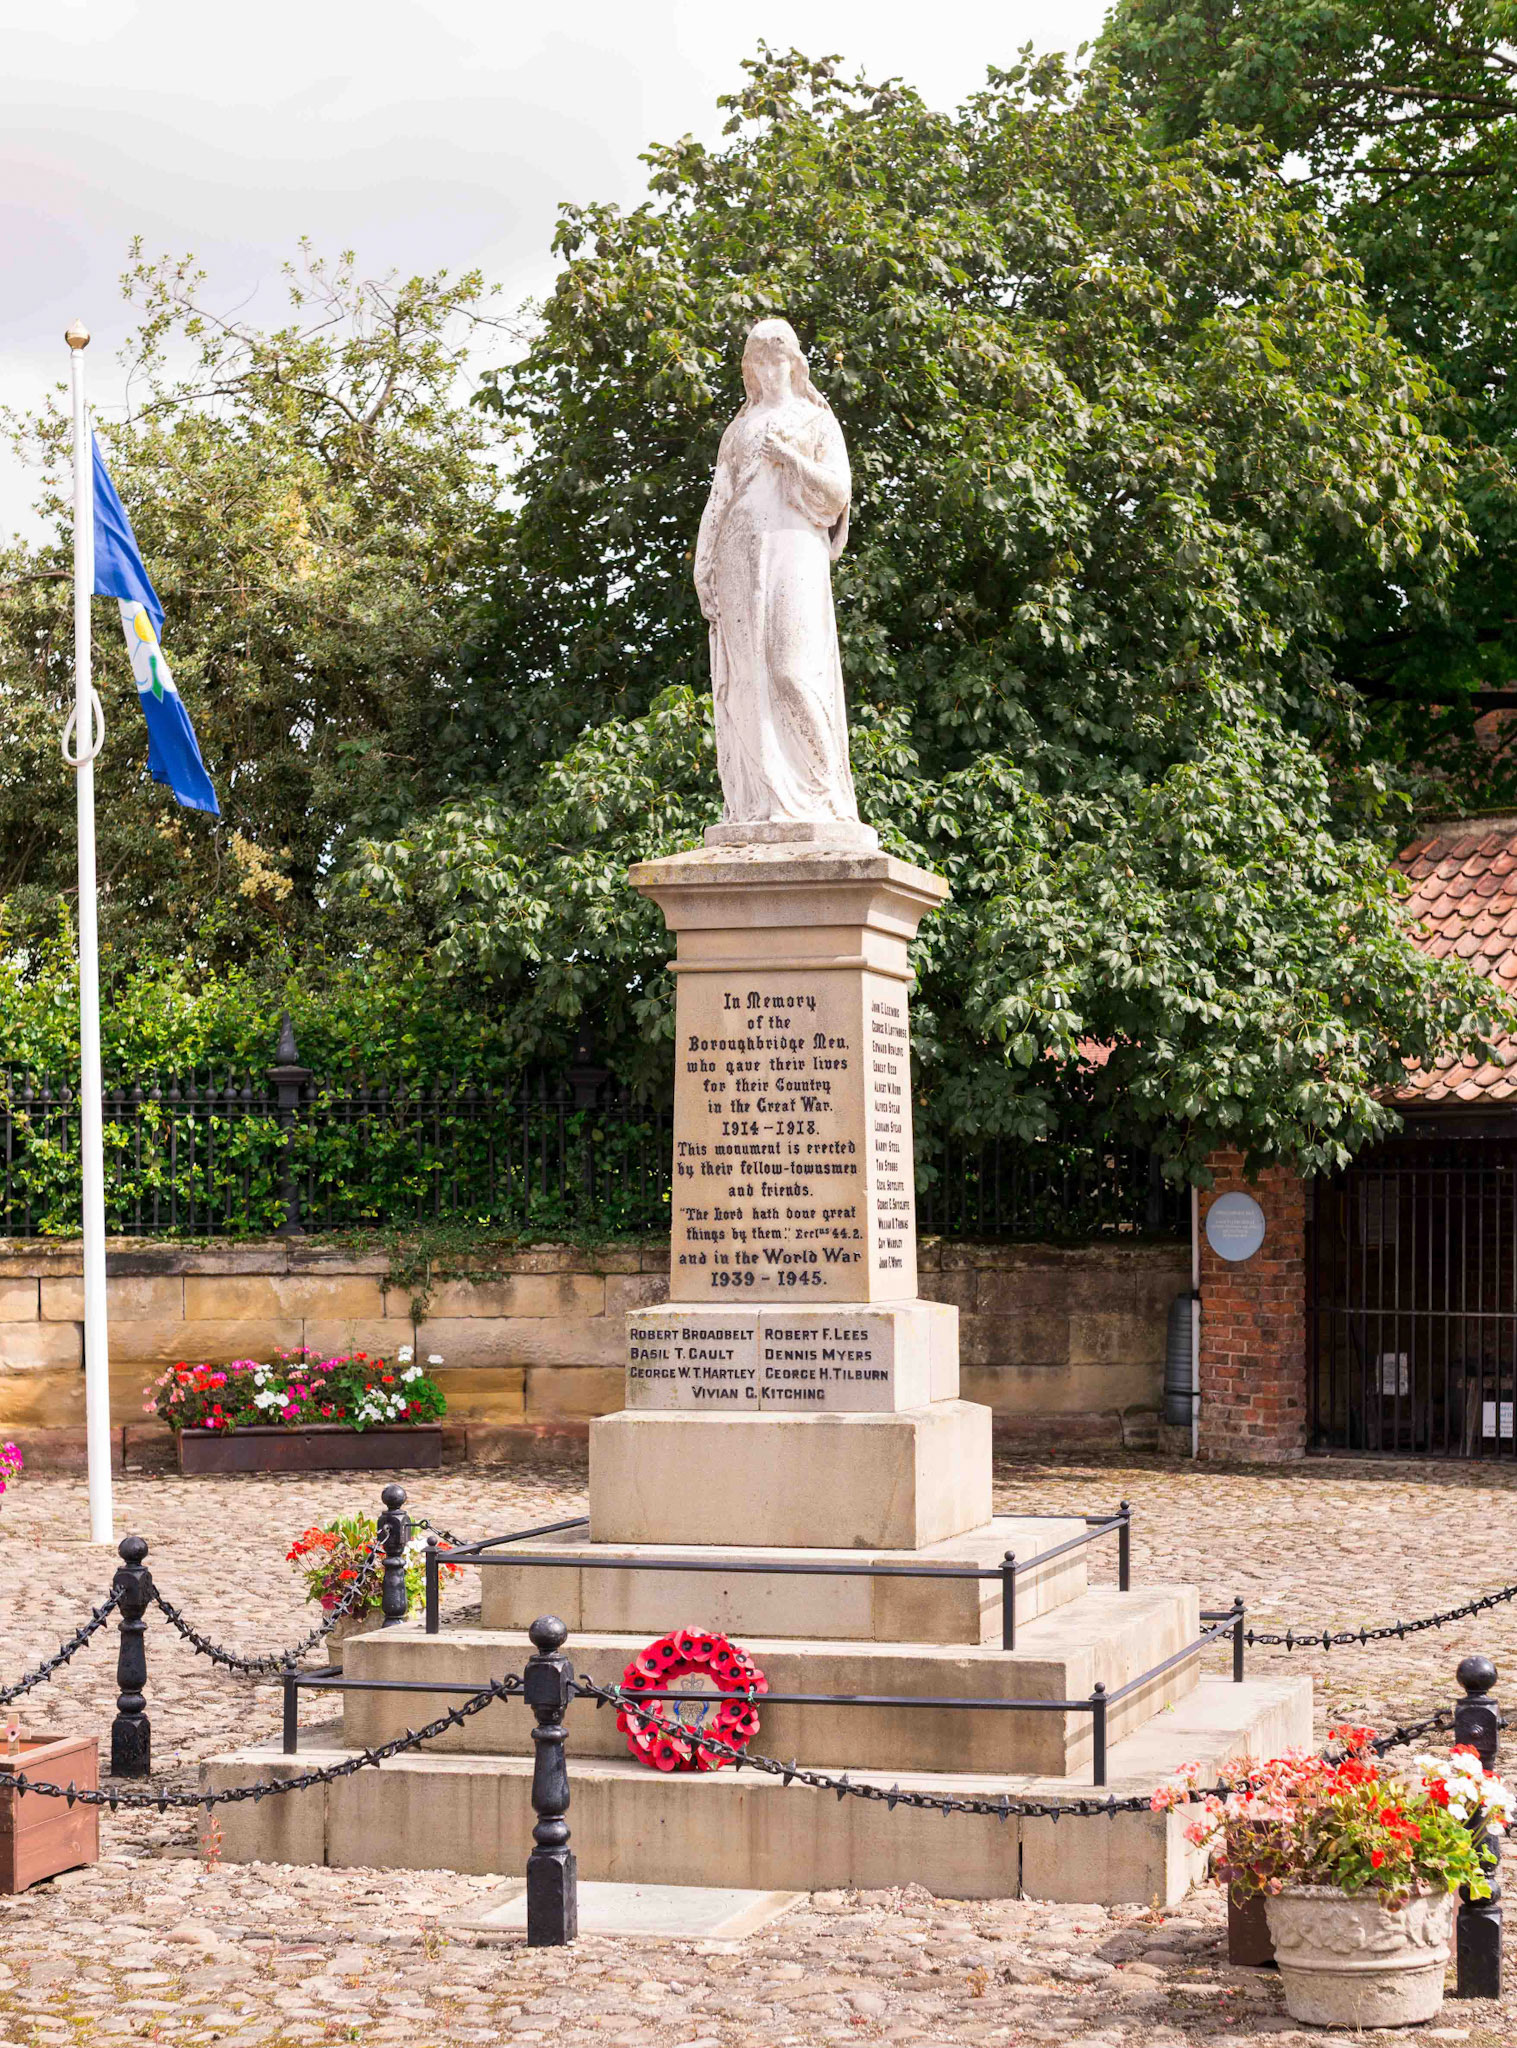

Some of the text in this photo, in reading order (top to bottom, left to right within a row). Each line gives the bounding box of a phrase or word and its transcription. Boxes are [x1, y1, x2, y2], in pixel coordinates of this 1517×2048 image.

[723, 991, 817, 1012] In Memory
[747, 1015, 792, 1030] of the
[688, 1032, 850, 1054] Boroughbridge Men,
[686, 1056, 848, 1076] who gave their lives
[703, 1077, 832, 1095] for their Country
[708, 1096, 833, 1114] in the Great War.
[677, 1139, 856, 1157] This monument is erected
[676, 1160, 858, 1179] by their fellow-townsmen
[728, 1181, 814, 1197] and friends.
[713, 1206, 743, 1221] Lord
[752, 1206, 780, 1221] hath
[786, 1206, 816, 1220] done
[822, 1205, 857, 1222] great
[686, 1226, 726, 1244] things
[731, 1226, 747, 1244] by
[678, 1247, 863, 1265] and in the World War
[711, 1271, 756, 1288] 1939
[777, 1270, 828, 1287] 1945.
[630, 1328, 755, 1341] ROBERT BROADBELT
[764, 1328, 819, 1341] ROBERT
[630, 1347, 670, 1360] BASIL
[765, 1348, 872, 1361] DENNIS MYERS
[691, 1385, 739, 1399] VIVIAN
[761, 1386, 826, 1400] KITCHING
